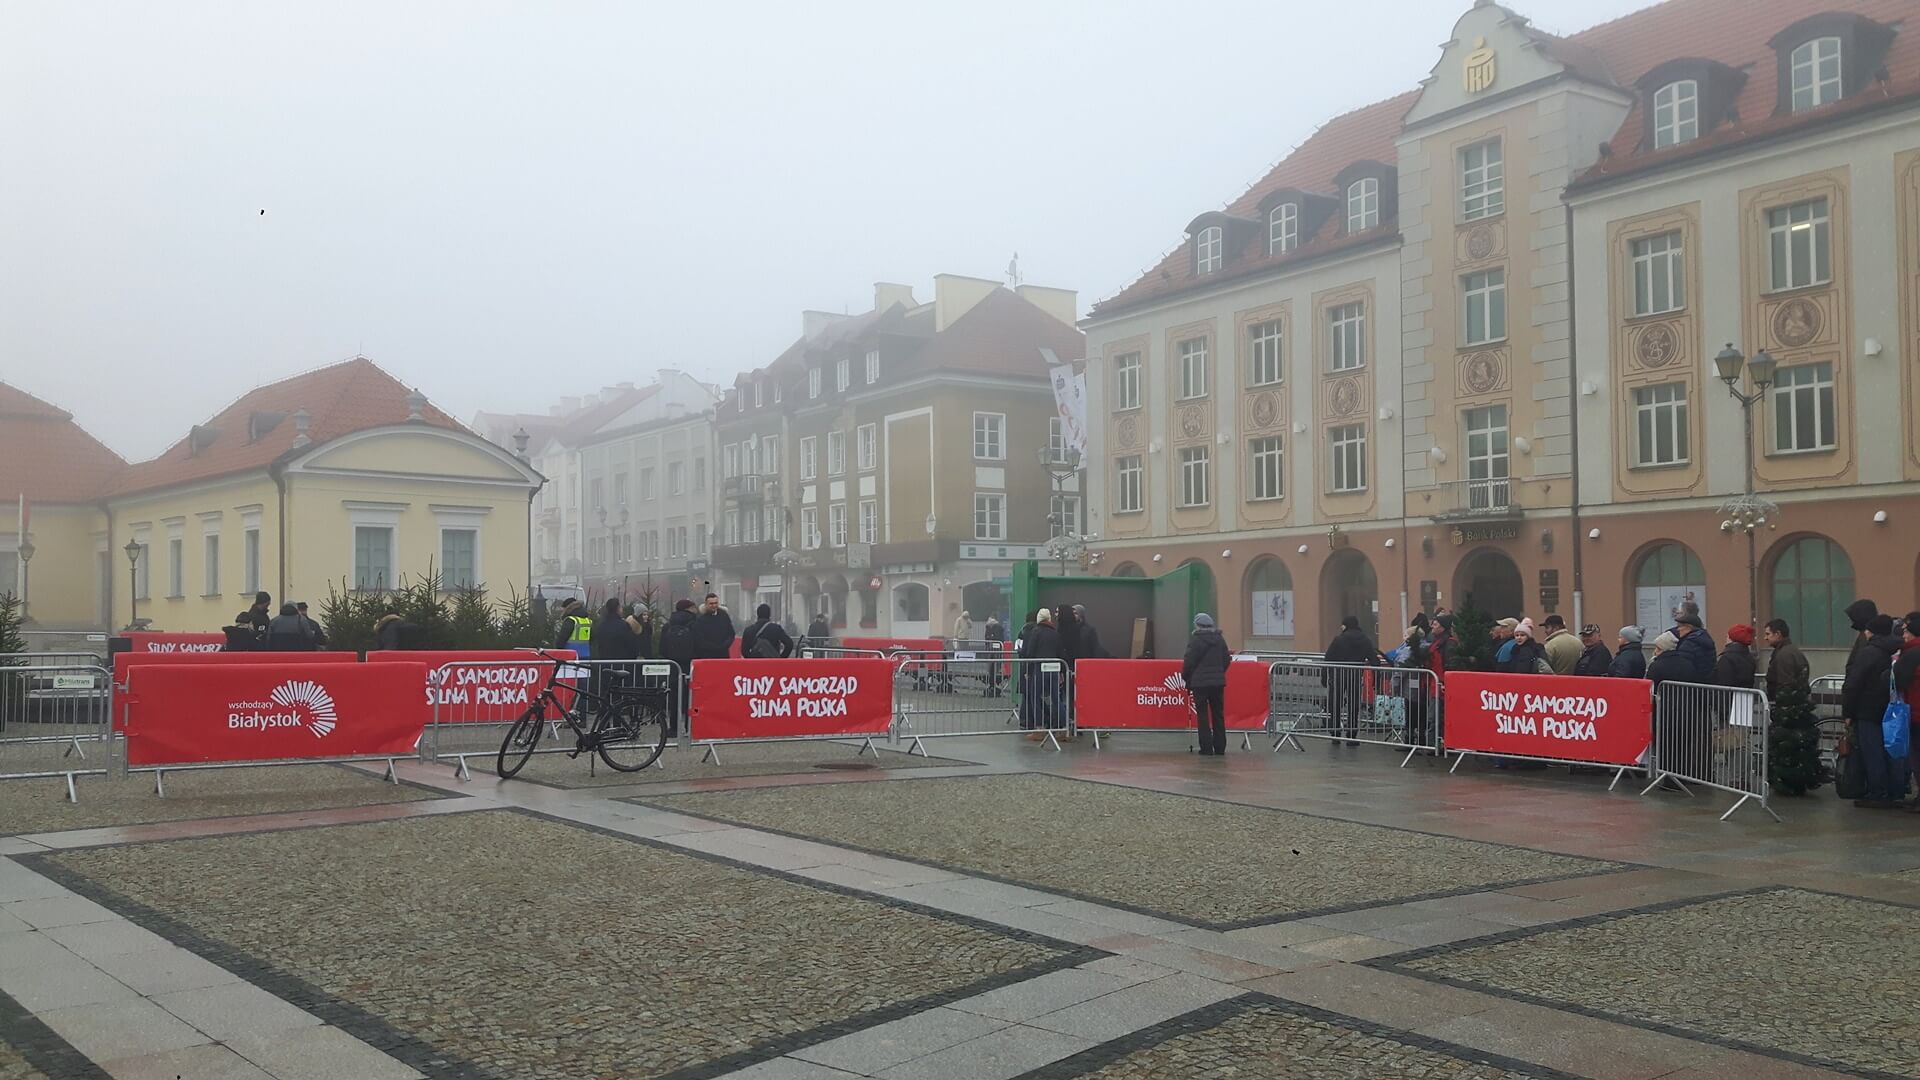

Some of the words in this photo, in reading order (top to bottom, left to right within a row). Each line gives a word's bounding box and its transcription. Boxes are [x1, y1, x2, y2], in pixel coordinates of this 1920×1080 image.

[456, 667, 539, 688] SAMORZĄD
[779, 676, 858, 699] SAMORZĄD
[228, 700, 274, 710] wschodzący
[476, 686, 529, 705] POLSKA
[1137, 693, 1185, 709] Białystok
[797, 697, 848, 718] POLSKA
[1523, 693, 1608, 722] SAMORZĄD
[228, 709, 302, 732] Białystok
[1542, 716, 1597, 741] POLSKA
